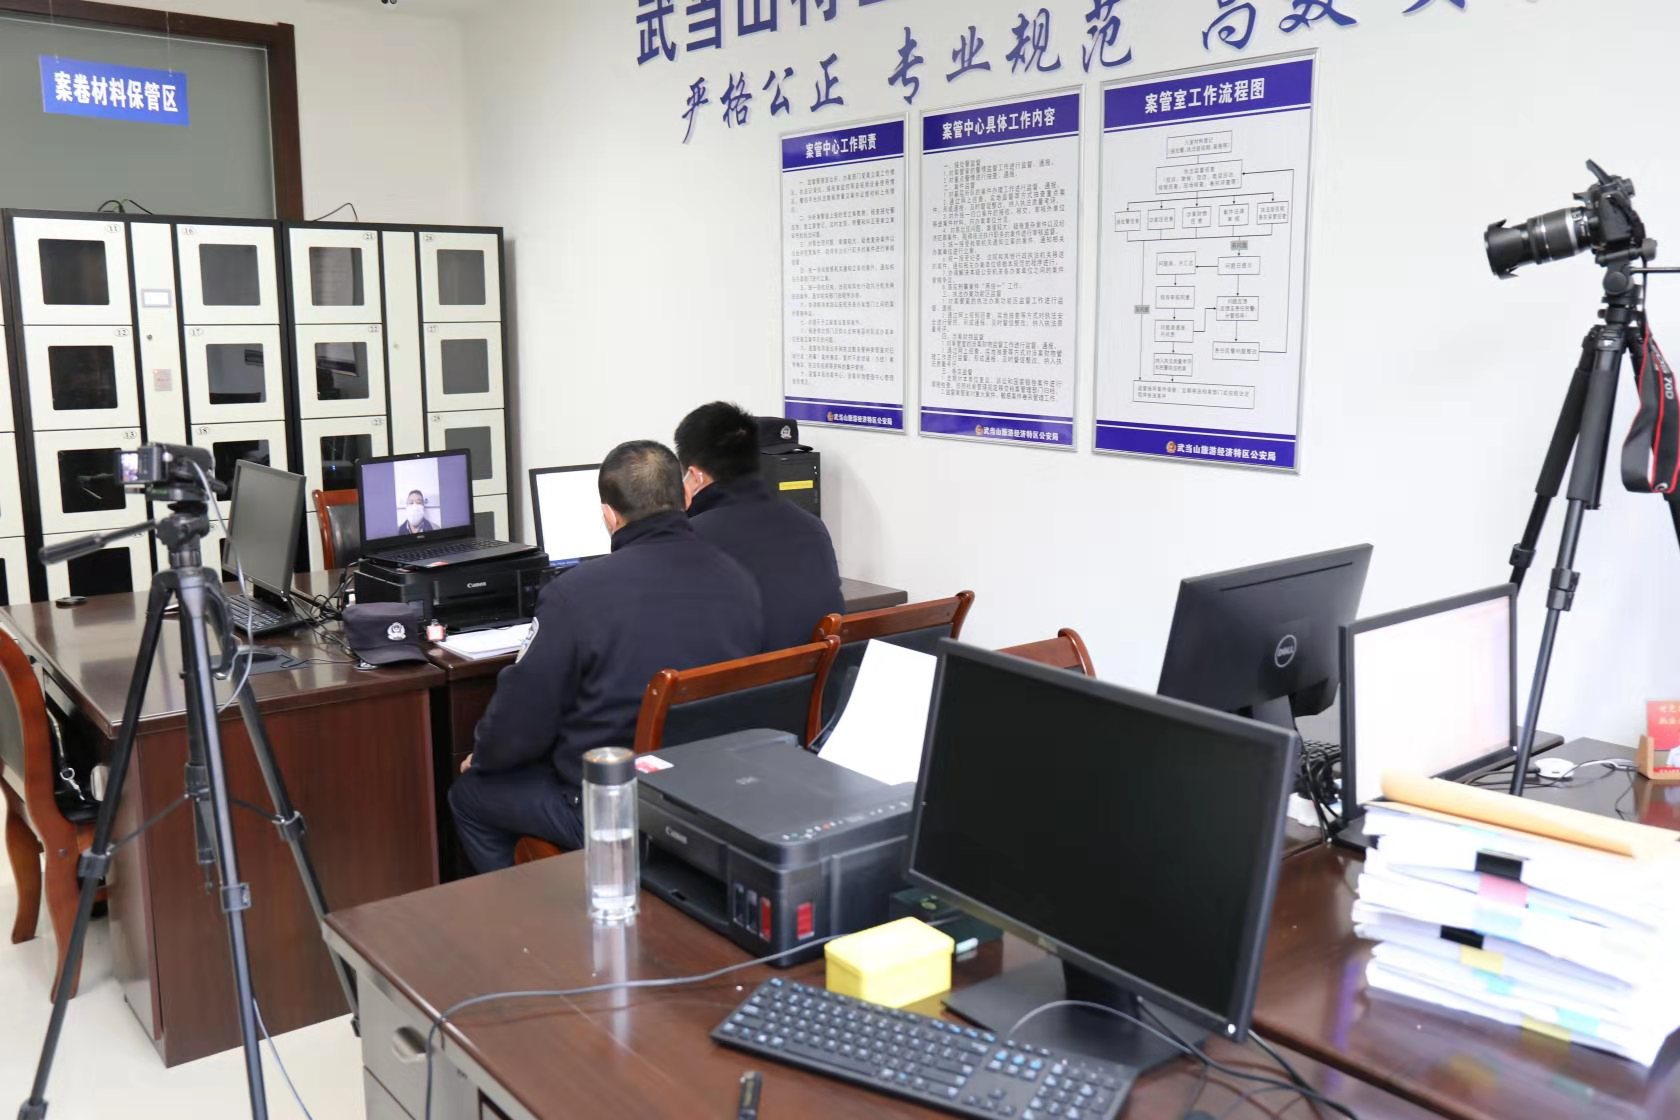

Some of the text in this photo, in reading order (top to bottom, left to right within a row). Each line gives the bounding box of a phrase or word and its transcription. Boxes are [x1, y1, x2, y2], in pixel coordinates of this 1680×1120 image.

[681, 53, 845, 145] 严格公正
[886, 0, 1132, 105] 专业规范
[54, 70, 178, 113] 案卷材料保管区
[1144, 77, 1265, 114] 案管室工作流程图
[942, 107, 1056, 140] 案管中心具体工作内容
[805, 133, 877, 159] 案管中心工作职责
[1663, 377, 1675, 400] 70D
[1176, 443, 1277, 462] 武当山旅游经济特区公安局
[664, 825, 688, 845] Canon
